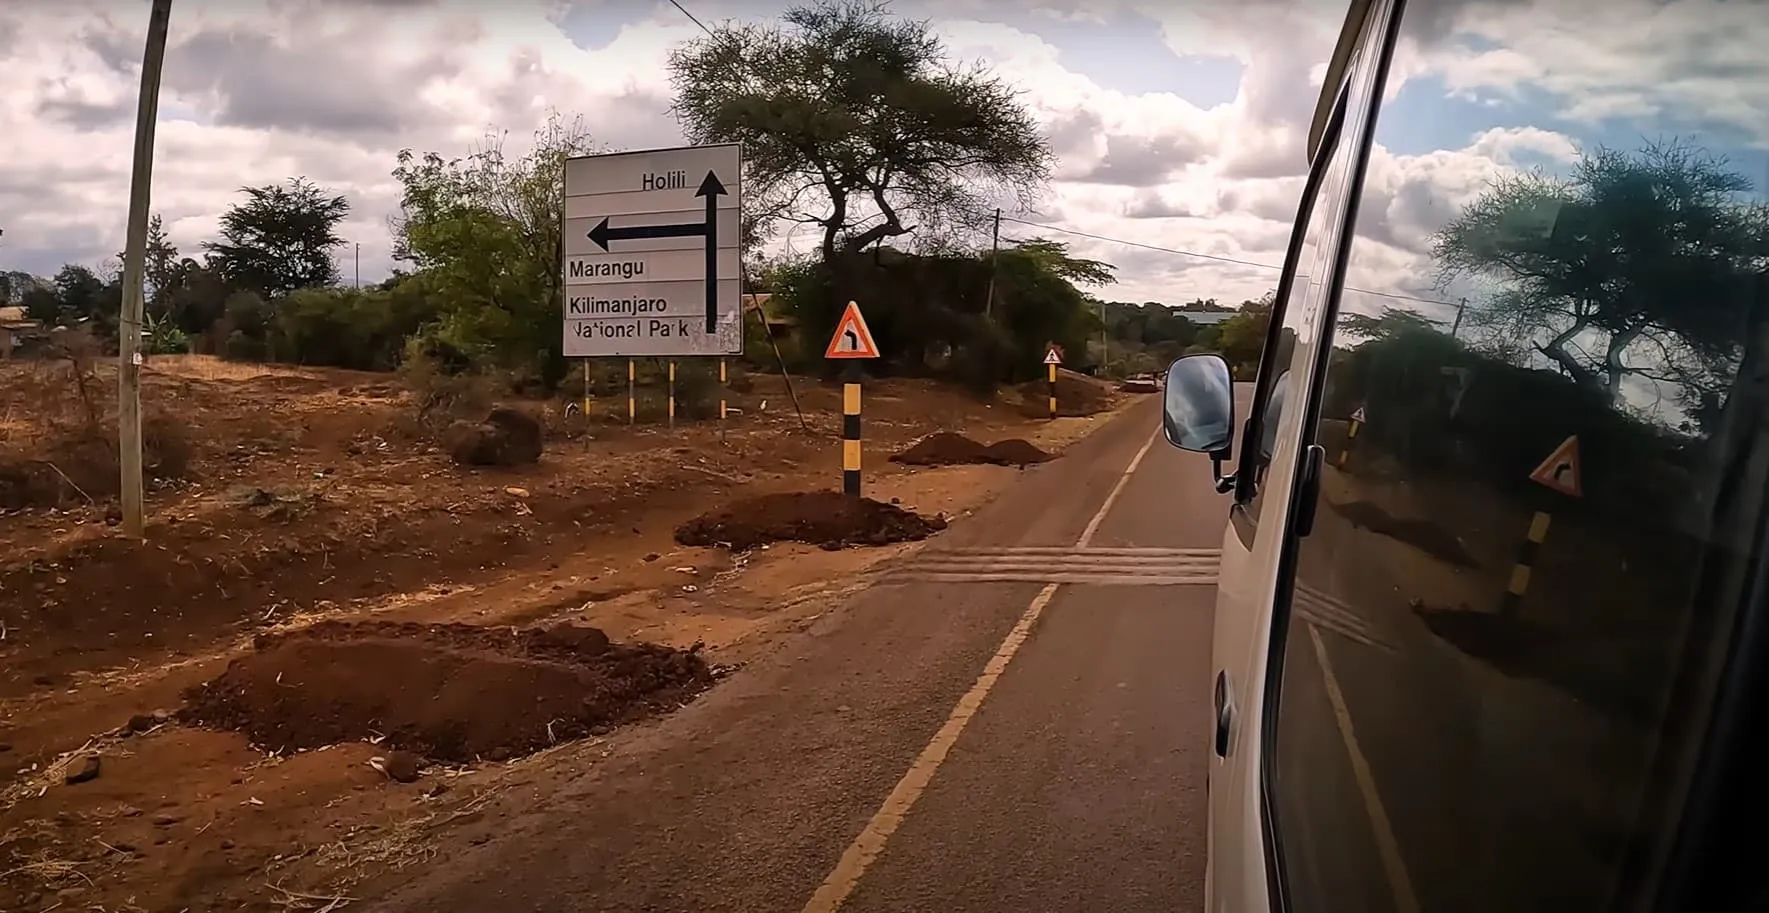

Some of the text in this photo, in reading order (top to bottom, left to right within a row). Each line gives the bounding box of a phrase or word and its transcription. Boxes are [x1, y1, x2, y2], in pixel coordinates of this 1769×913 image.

[642, 170, 687, 191] Holili
[569, 260, 644, 278] Marangu
[570, 296, 667, 316] Kilimanjaro
